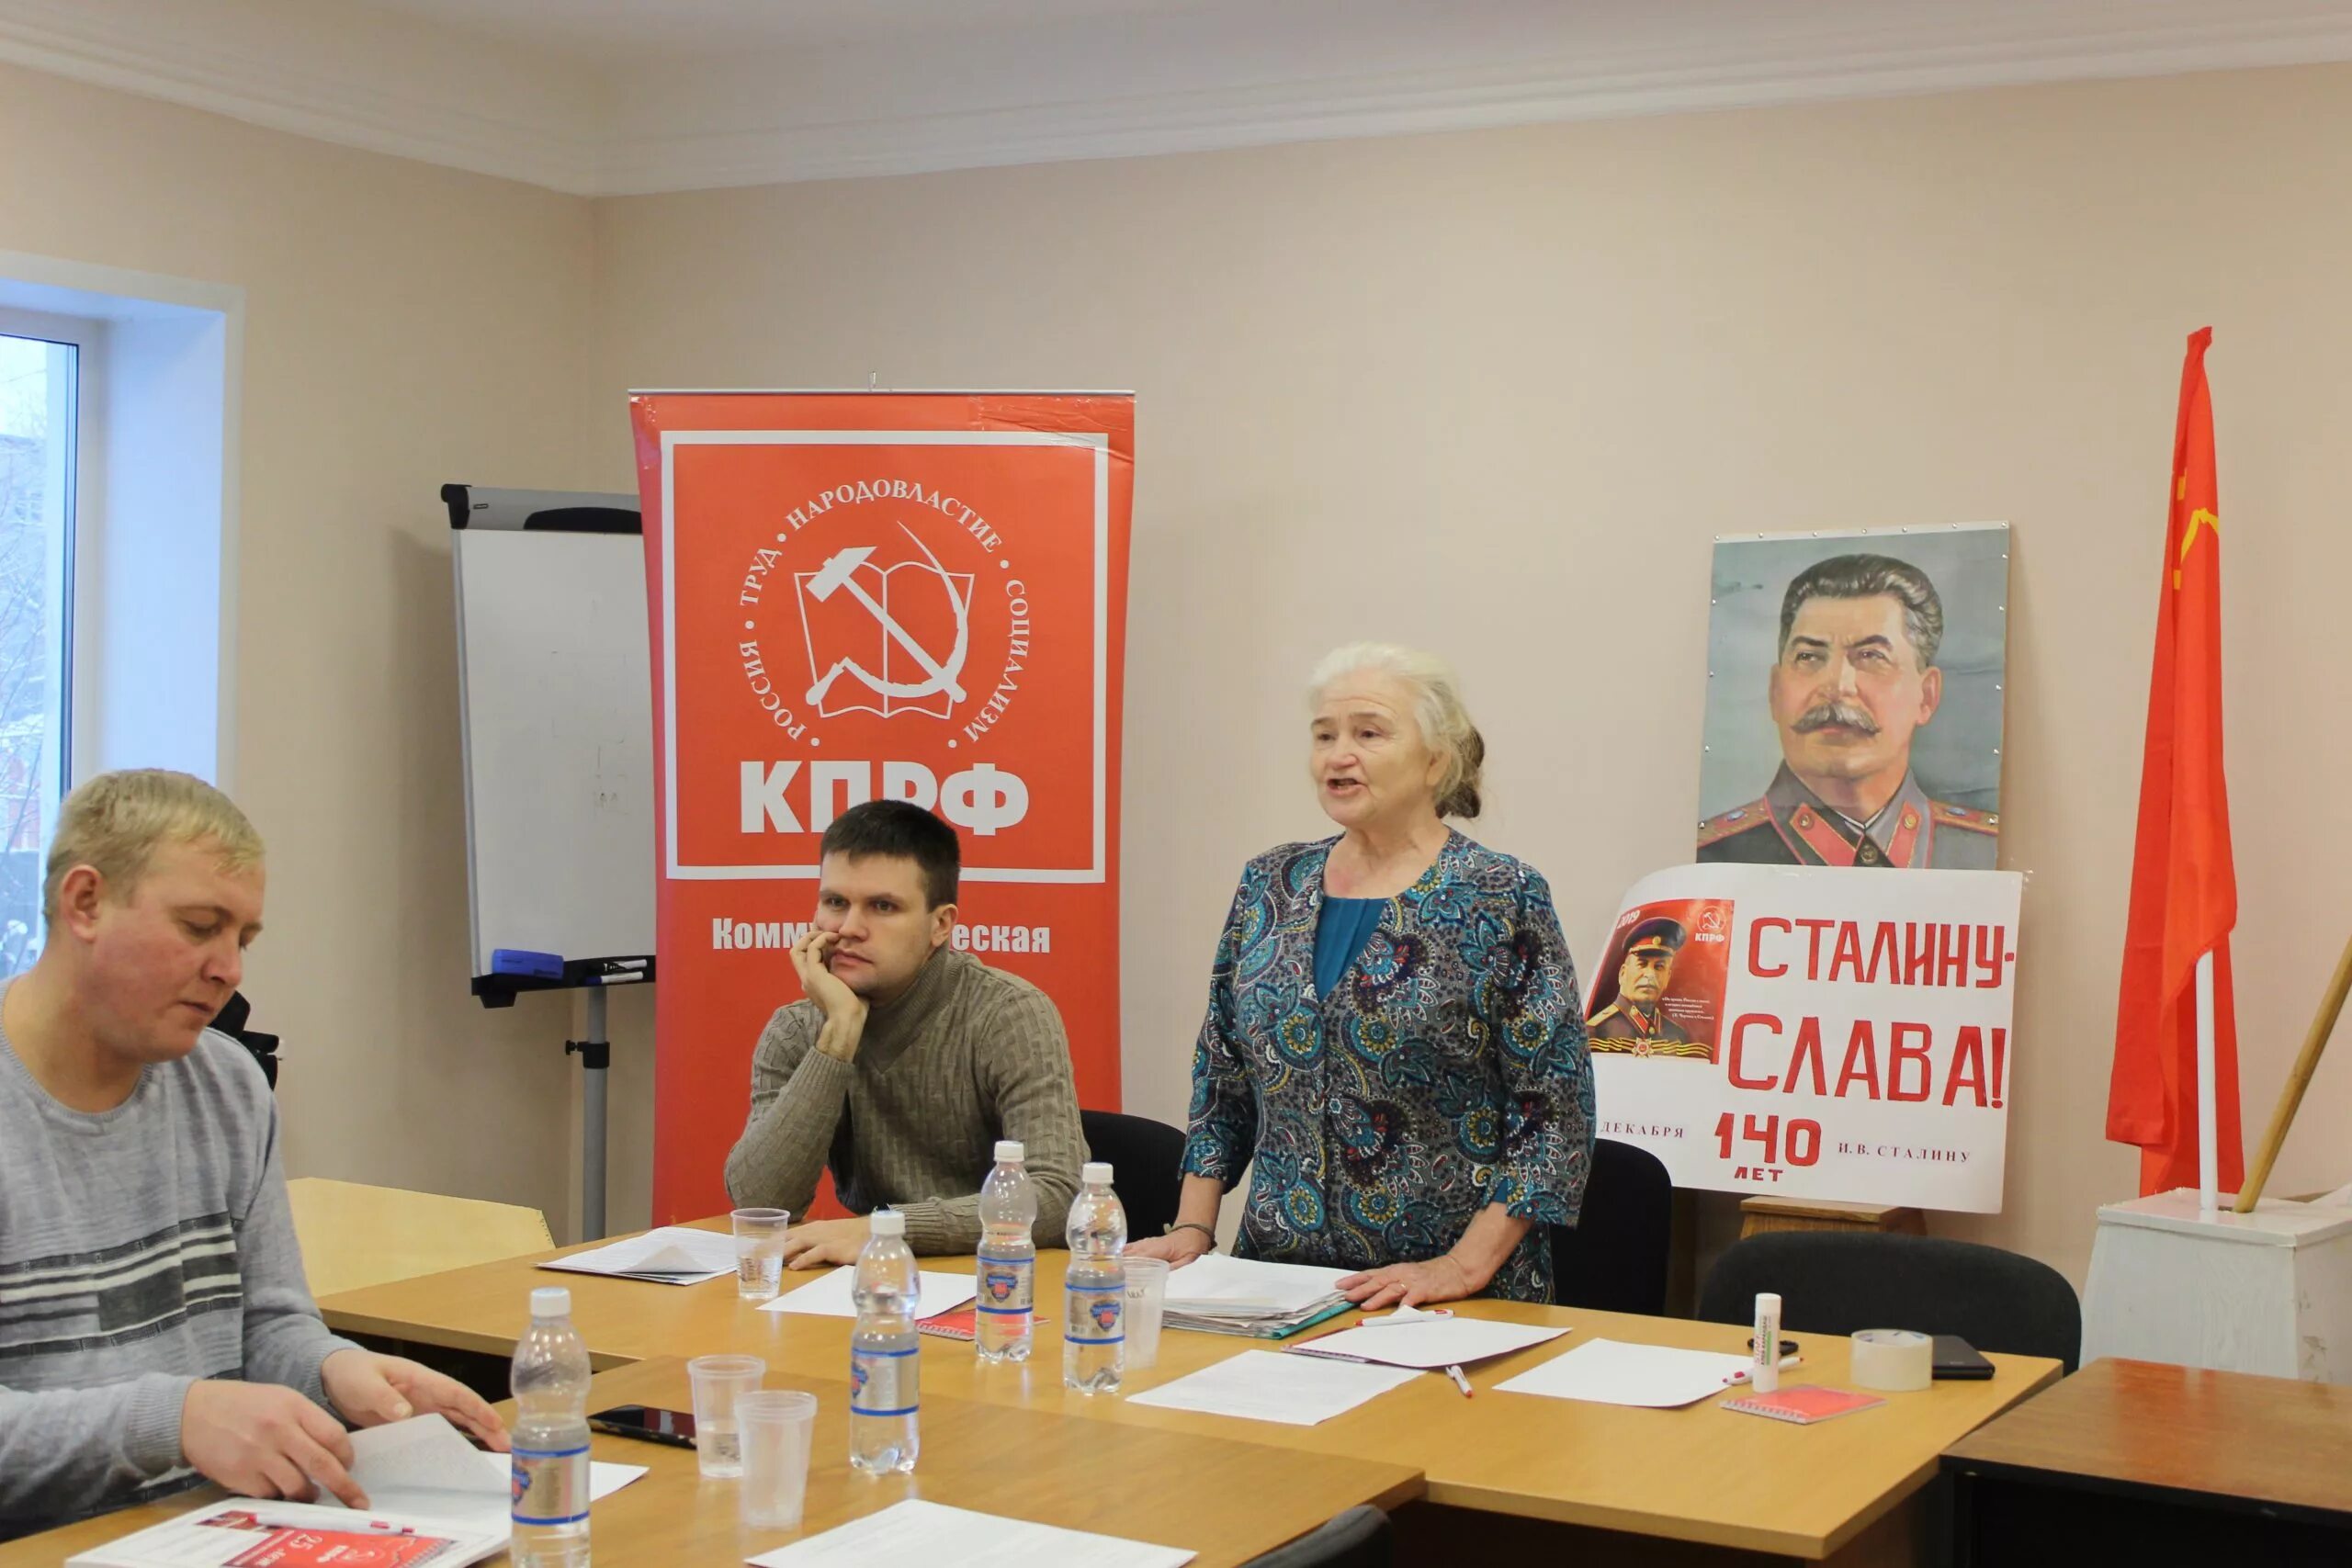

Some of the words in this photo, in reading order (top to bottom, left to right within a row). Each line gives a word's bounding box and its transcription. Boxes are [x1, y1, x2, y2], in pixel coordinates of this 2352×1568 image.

[785, 478, 1003, 555] НАРОДОВЛАСТИЕ
[740, 546, 783, 607] ТРУД
[962, 578, 1031, 745] СОЦИАЛИЗМ
[739, 641, 808, 742] РОССИЯ
[712, 917, 1051, 953] Коммеская
[1617, 909, 1641, 930] 2019
[1695, 932, 1725, 942] КПРФ
[1727, 1012, 2007, 1110] СЛАВА!
[1600, 1122, 1683, 1138] ДЕКАБРЯ
[1713, 1111, 1821, 1168] 140
[1734, 1167, 1784, 1183] ЛЕТ
[1877, 1145, 1970, 1163] СТАЛИНУ
